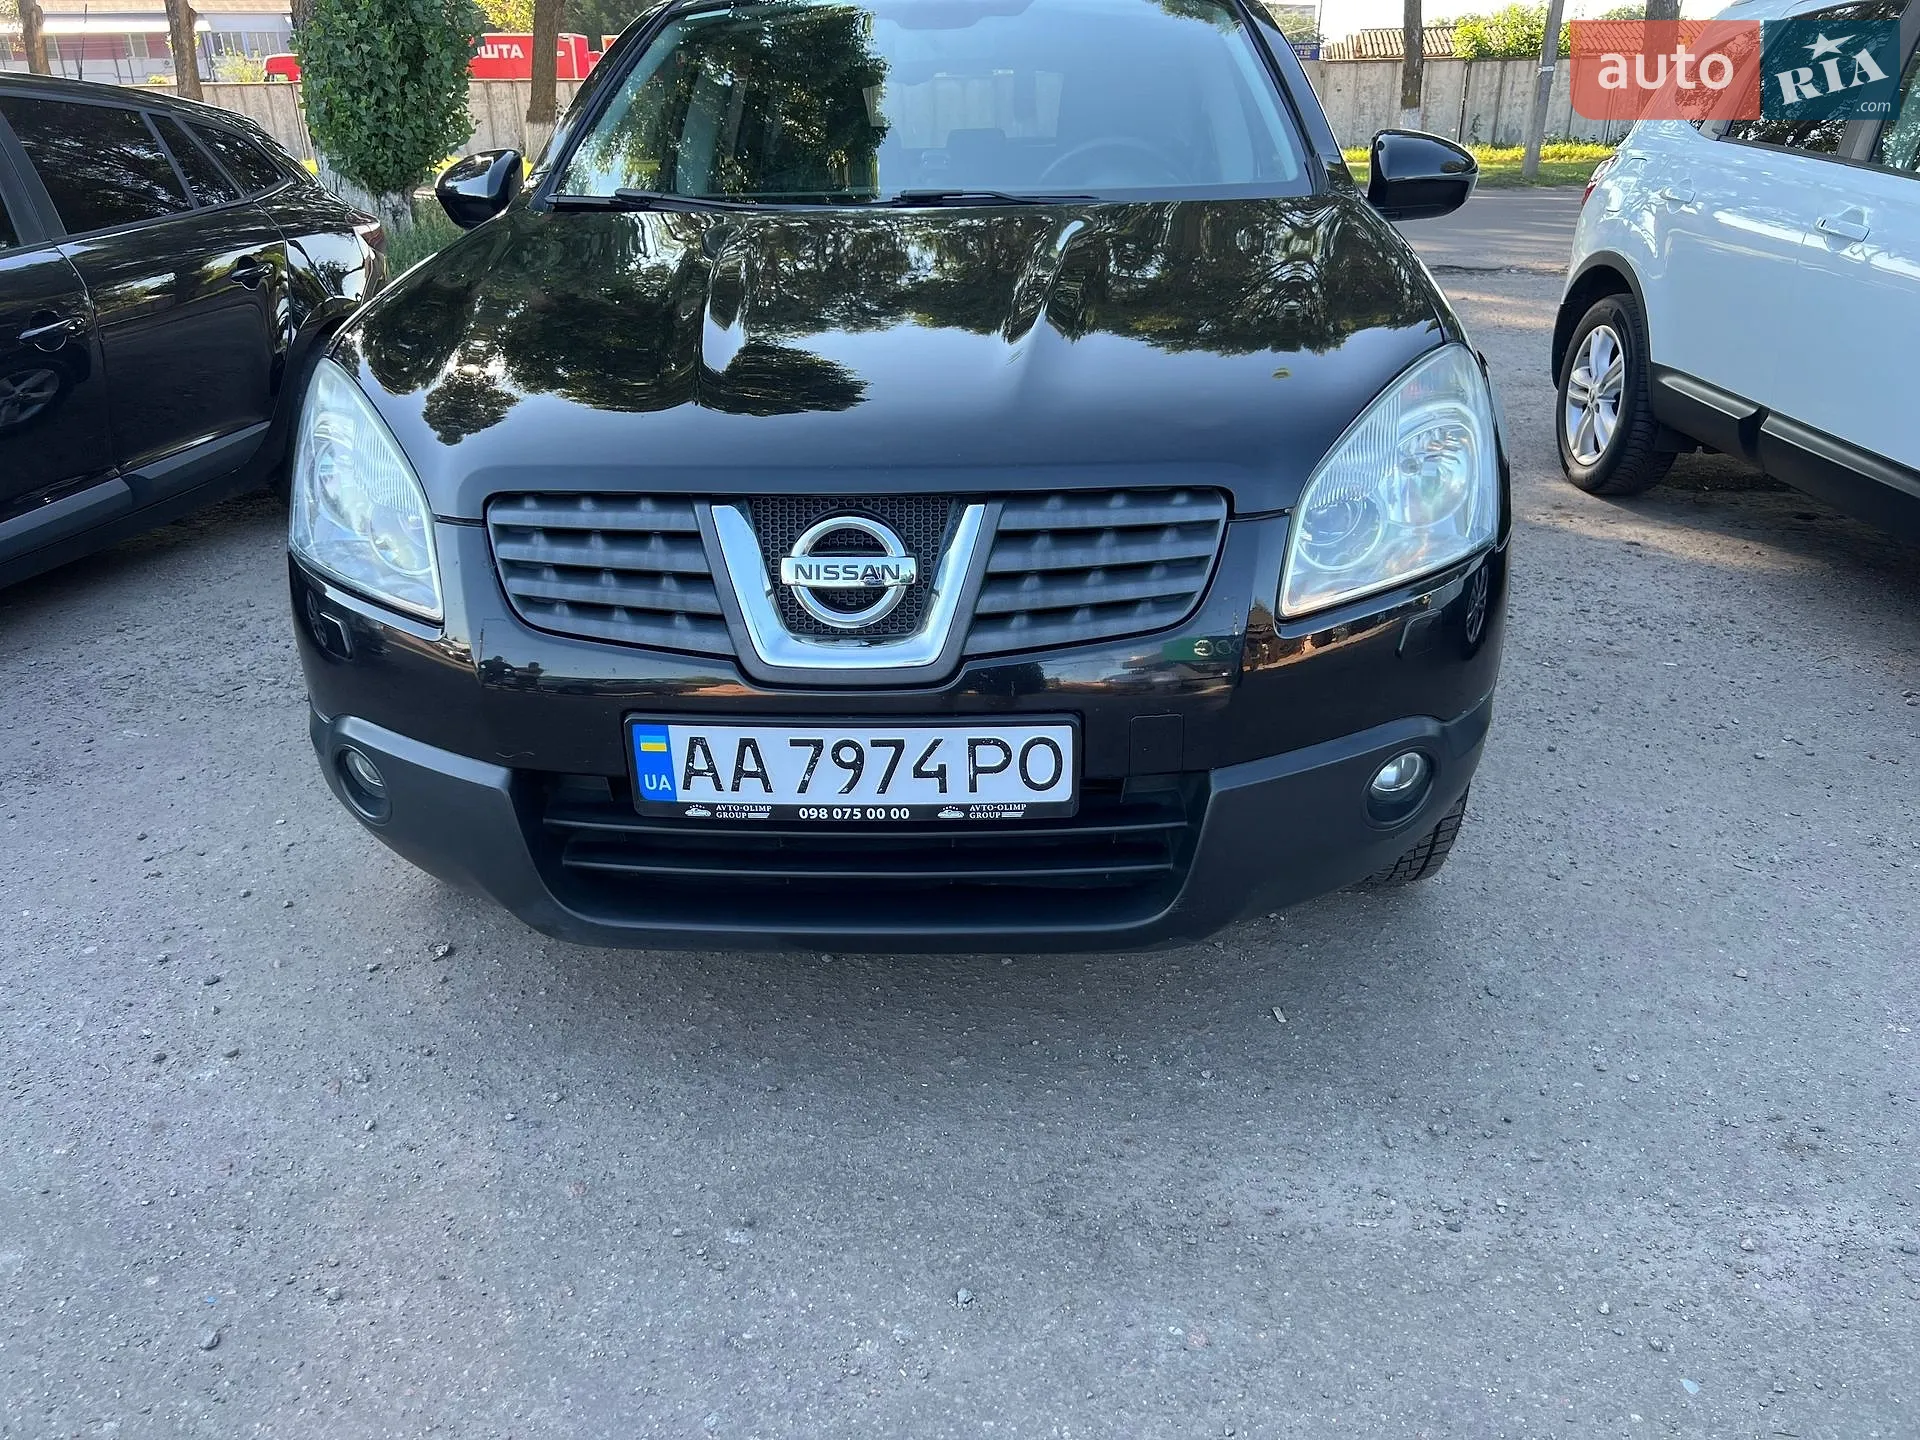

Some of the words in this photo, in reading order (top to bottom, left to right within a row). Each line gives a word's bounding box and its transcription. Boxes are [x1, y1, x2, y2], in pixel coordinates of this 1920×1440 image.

[794, 563, 900, 581] NISSAN
[682, 736, 774, 794] AA
[789, 737, 948, 795] 7974
[966, 736, 1064, 794] PO
[644, 773, 672, 791] UA
[715, 804, 772, 812] AVTO-OLIMP
[798, 807, 829, 820] 098
[832, 807, 862, 820] 075
[866, 807, 886, 820] 00
[890, 807, 910, 820] 00
[969, 803, 1027, 812] AVTO-OLIMP
[969, 811, 1001, 819] GROUP
